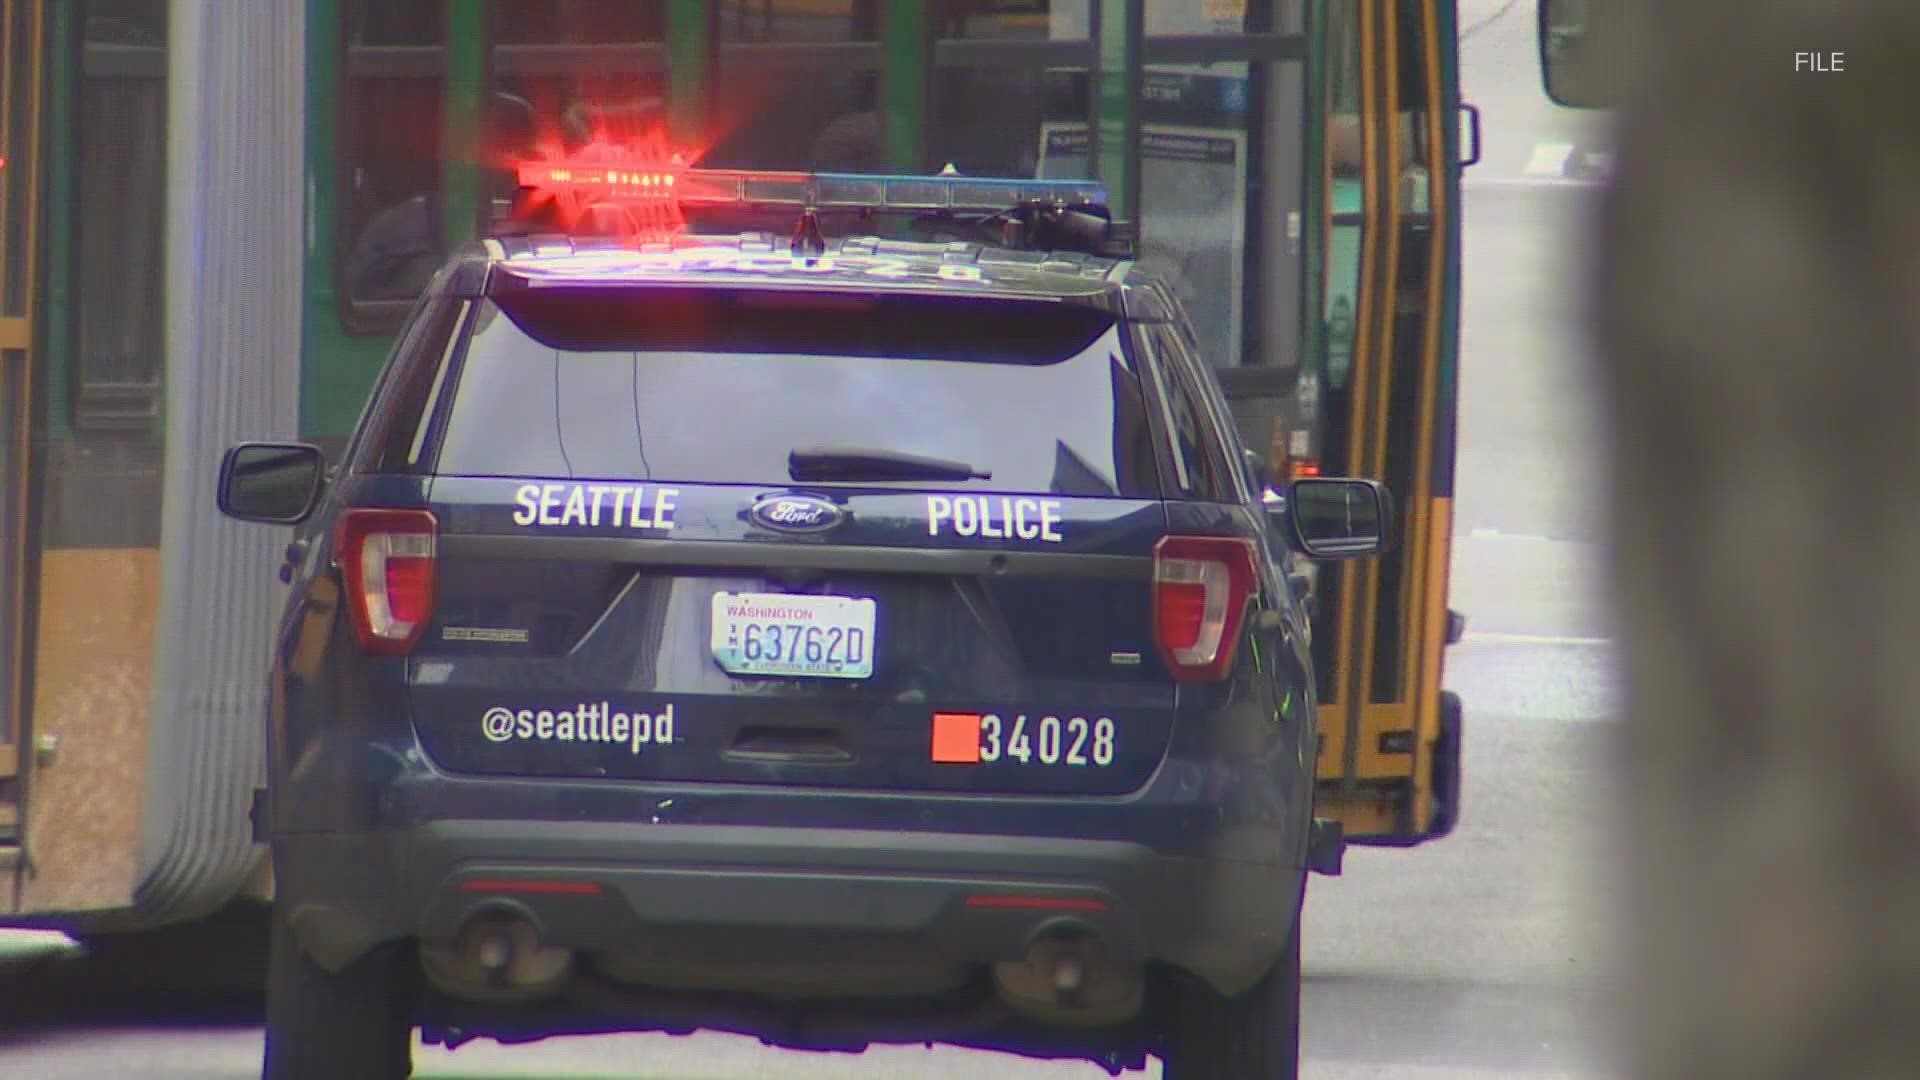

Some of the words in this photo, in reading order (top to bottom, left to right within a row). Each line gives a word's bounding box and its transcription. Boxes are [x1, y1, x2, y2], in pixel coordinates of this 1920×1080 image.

[513, 484, 680, 529] SEATTLE
[770, 500, 823, 525] Ford
[927, 495, 1063, 543] POLICE
[727, 606, 813, 620] WASHINGTON
[744, 623, 864, 665] 63762D
[482, 701, 674, 755] @seattlepd
[980, 714, 1115, 766] 34028
